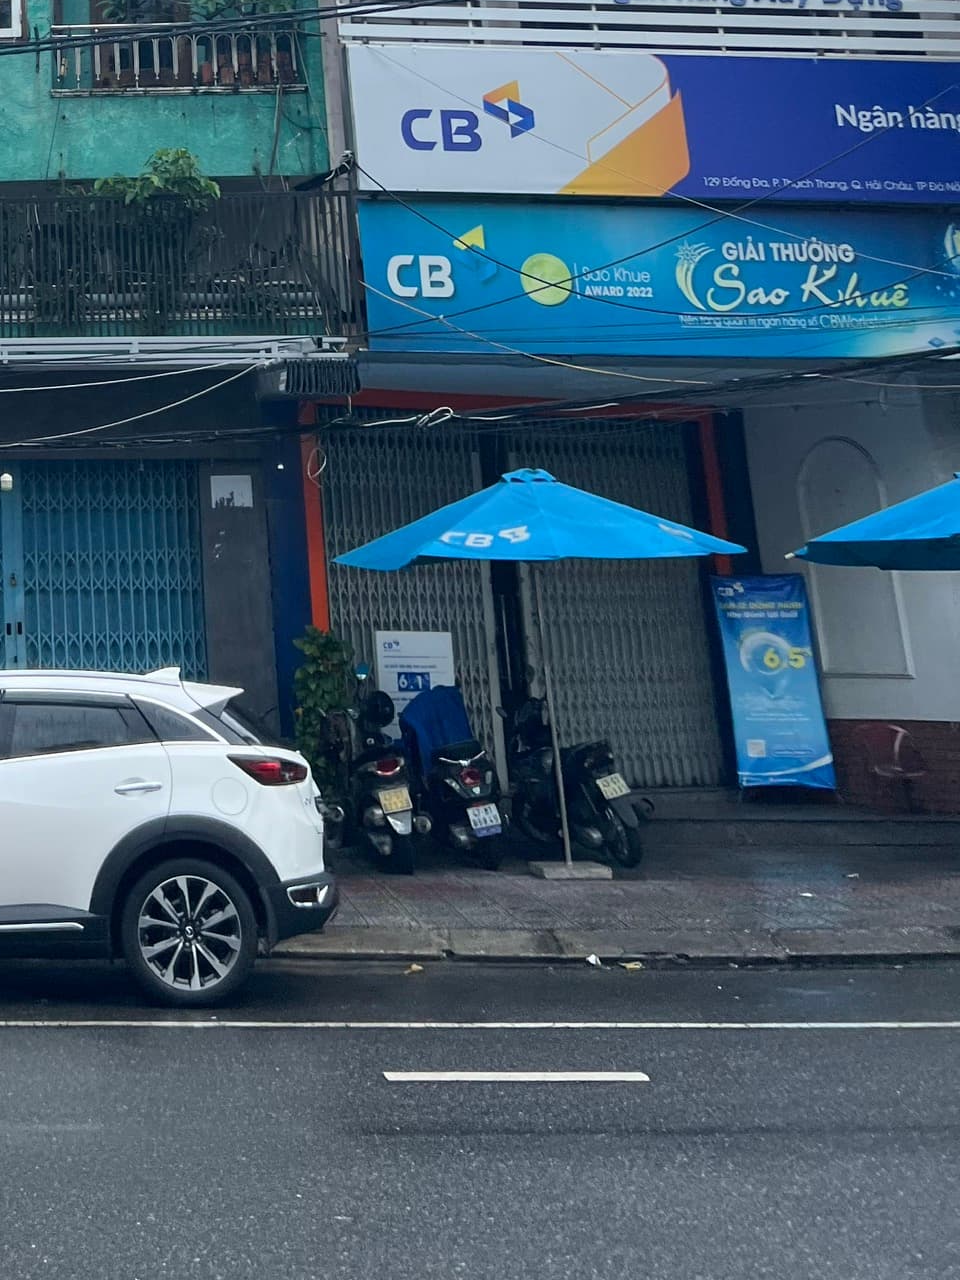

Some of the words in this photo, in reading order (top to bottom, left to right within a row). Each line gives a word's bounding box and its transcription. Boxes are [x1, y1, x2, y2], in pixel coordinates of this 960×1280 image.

[401, 108, 482, 152] CB
[834, 104, 904, 133] Ngân
[703, 176, 721, 187] 129
[721, 235, 765, 262] GIẢI
[769, 236, 855, 263] THƯỞNG
[386, 255, 455, 298] CB
[581, 267, 611, 283] Sao
[614, 267, 651, 283] Khue
[706, 263, 790, 312] Sao
[802, 264, 909, 308] Khuê
[584, 285, 624, 297] AWARD
[626, 286, 653, 298] 2022
[439, 531, 494, 548] CB
